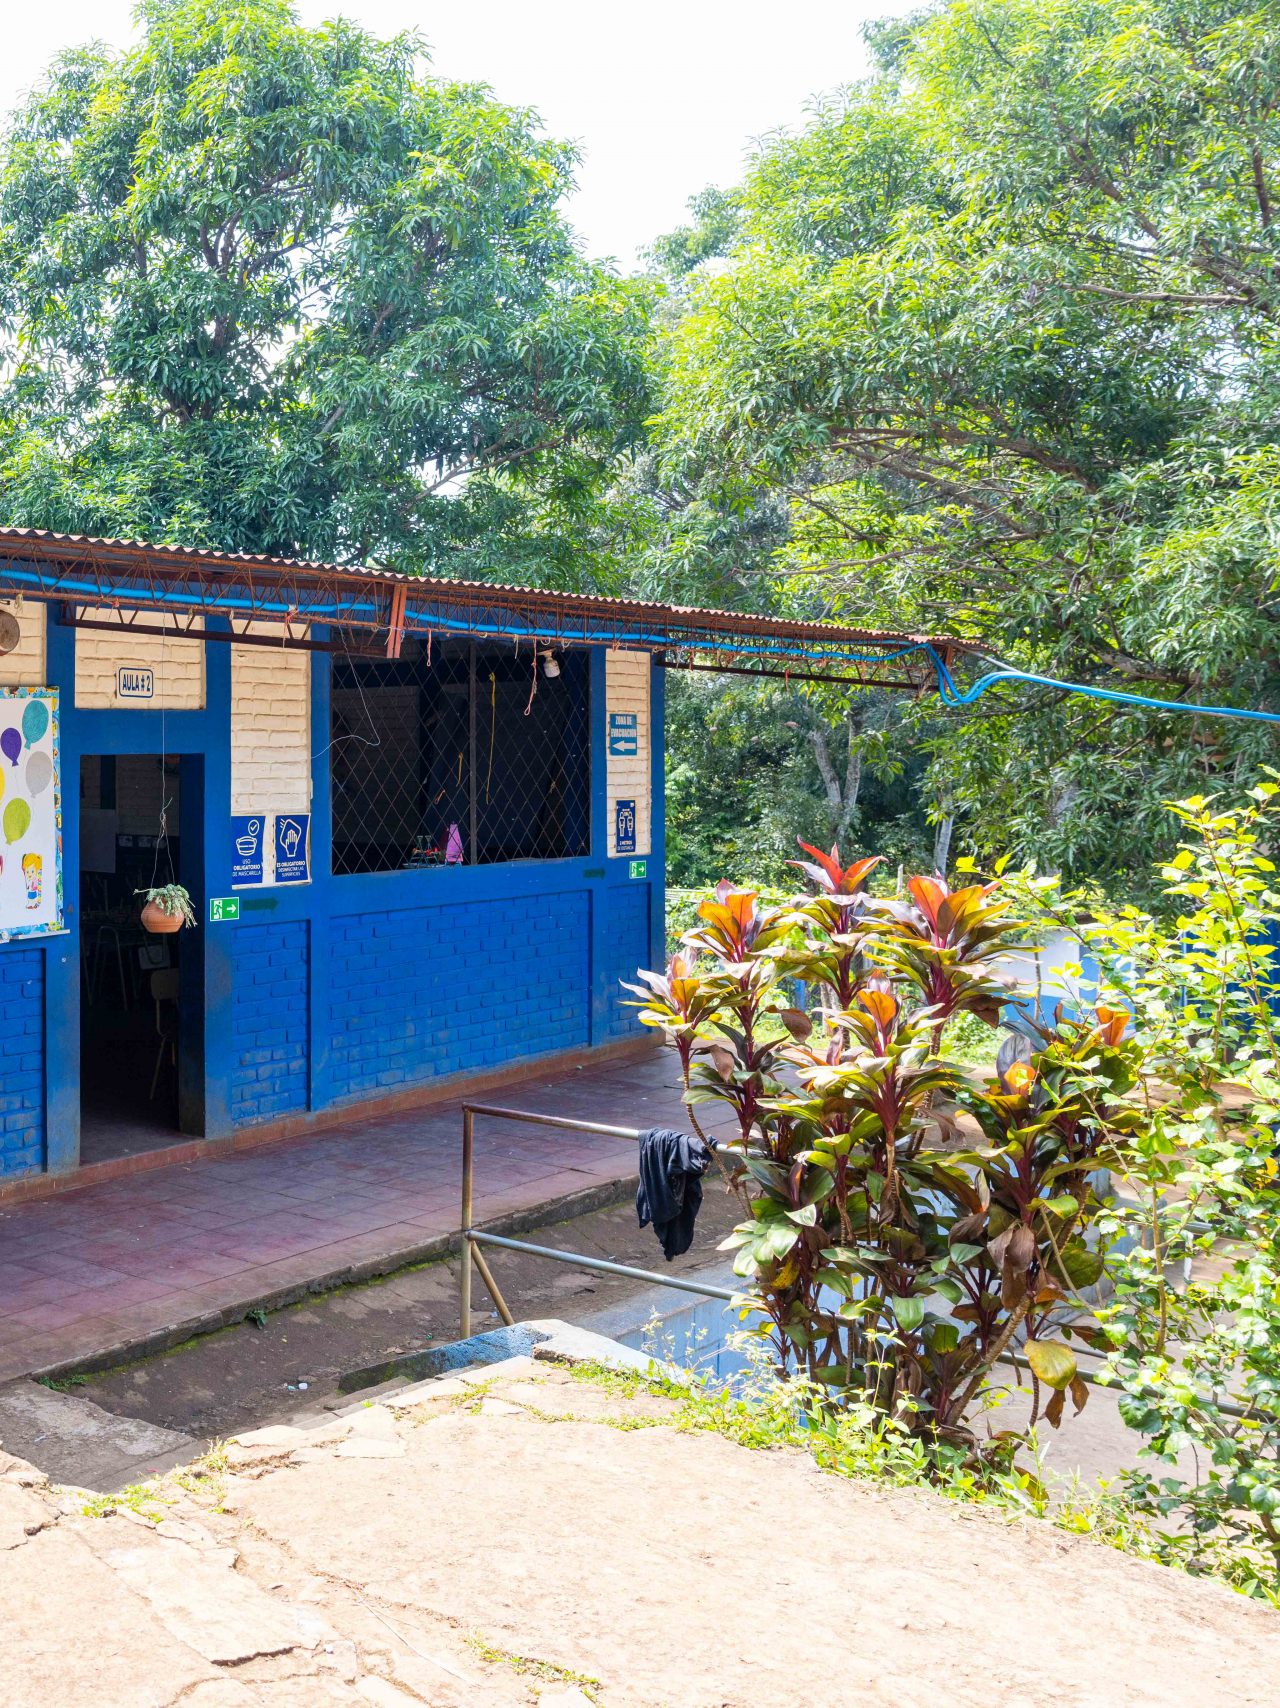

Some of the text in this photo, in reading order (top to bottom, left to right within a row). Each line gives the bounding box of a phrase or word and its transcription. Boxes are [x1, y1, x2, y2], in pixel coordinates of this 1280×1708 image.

[122, 673, 140, 691] AULA
[146, 674, 151, 692] 2
[615, 716, 632, 725] ZONA DE
